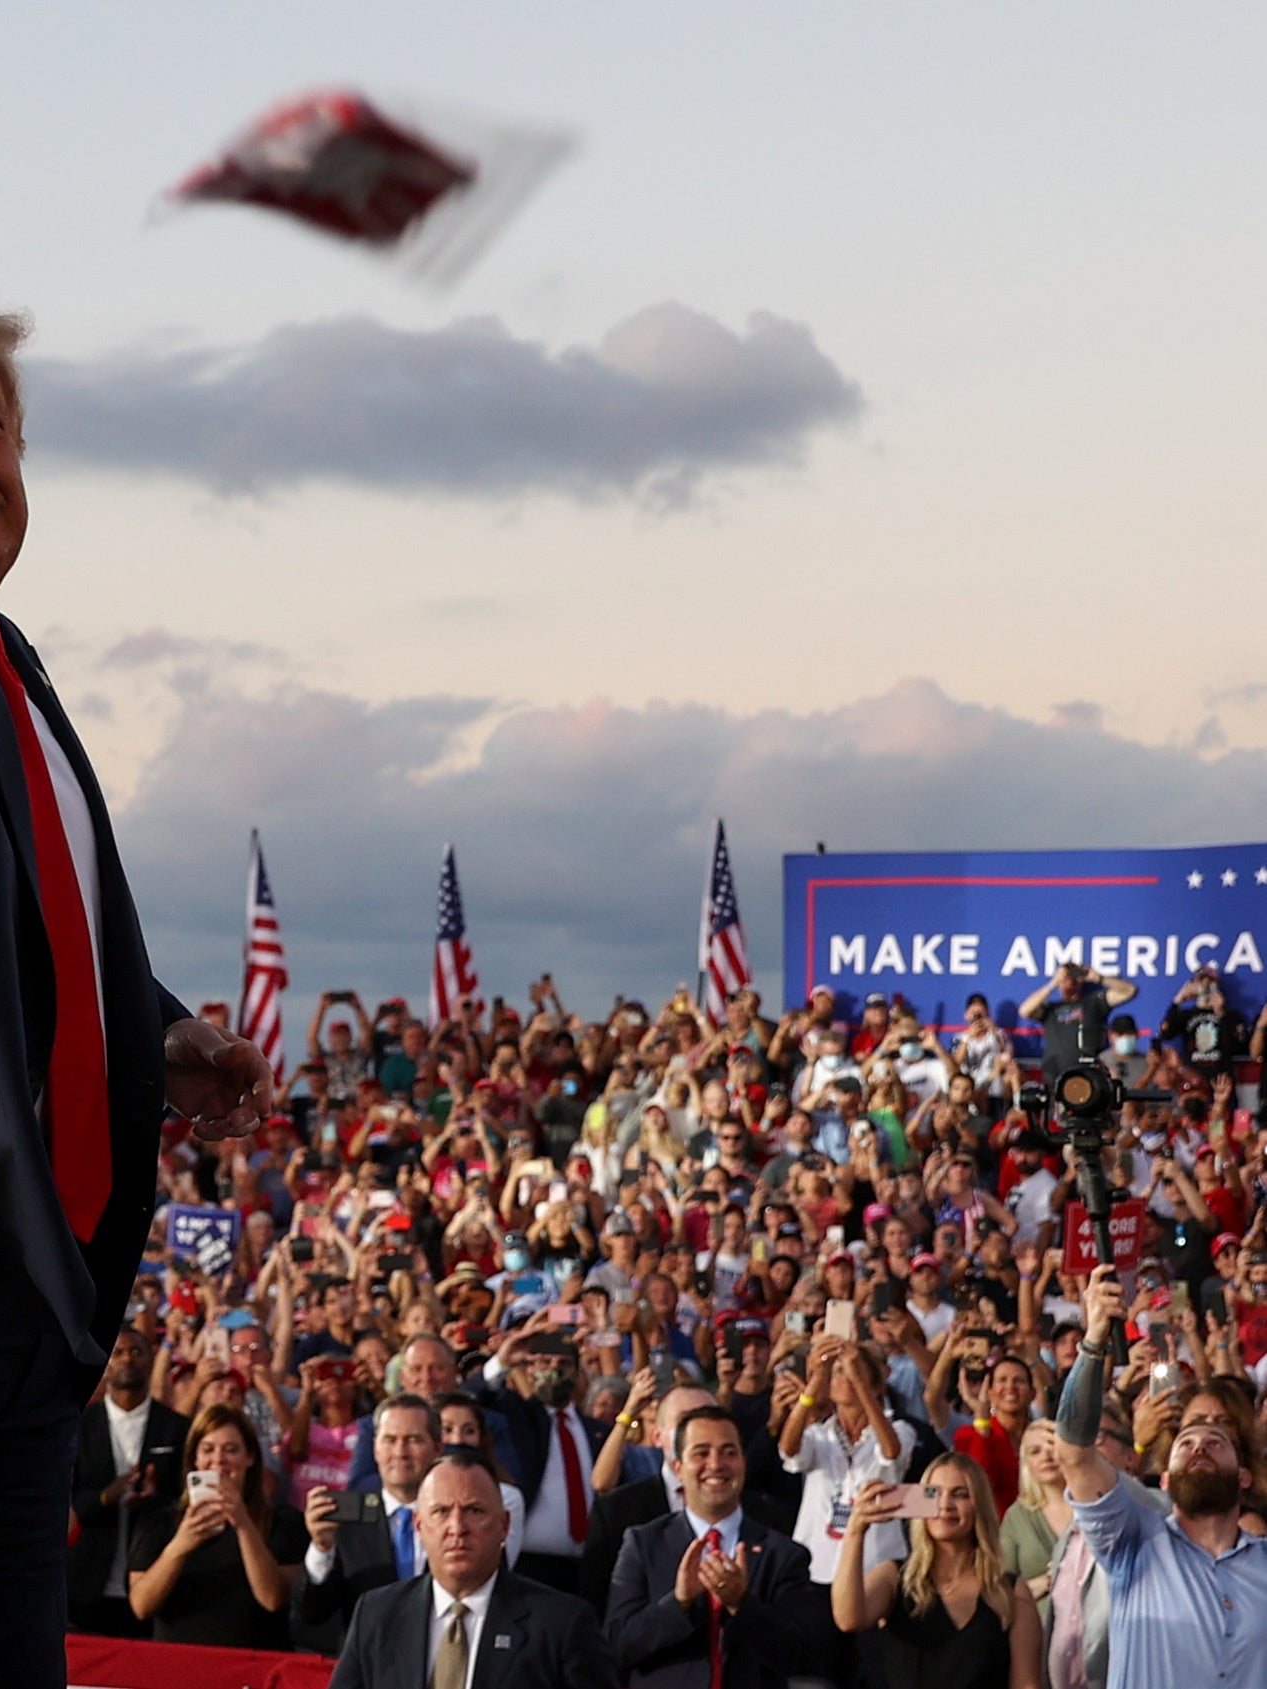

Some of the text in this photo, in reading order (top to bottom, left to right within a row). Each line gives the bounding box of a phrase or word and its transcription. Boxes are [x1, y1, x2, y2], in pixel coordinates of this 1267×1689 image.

[829, 931, 1264, 977] MAKE AMERICA
[1077, 1216, 1139, 1237] 4 ORE
